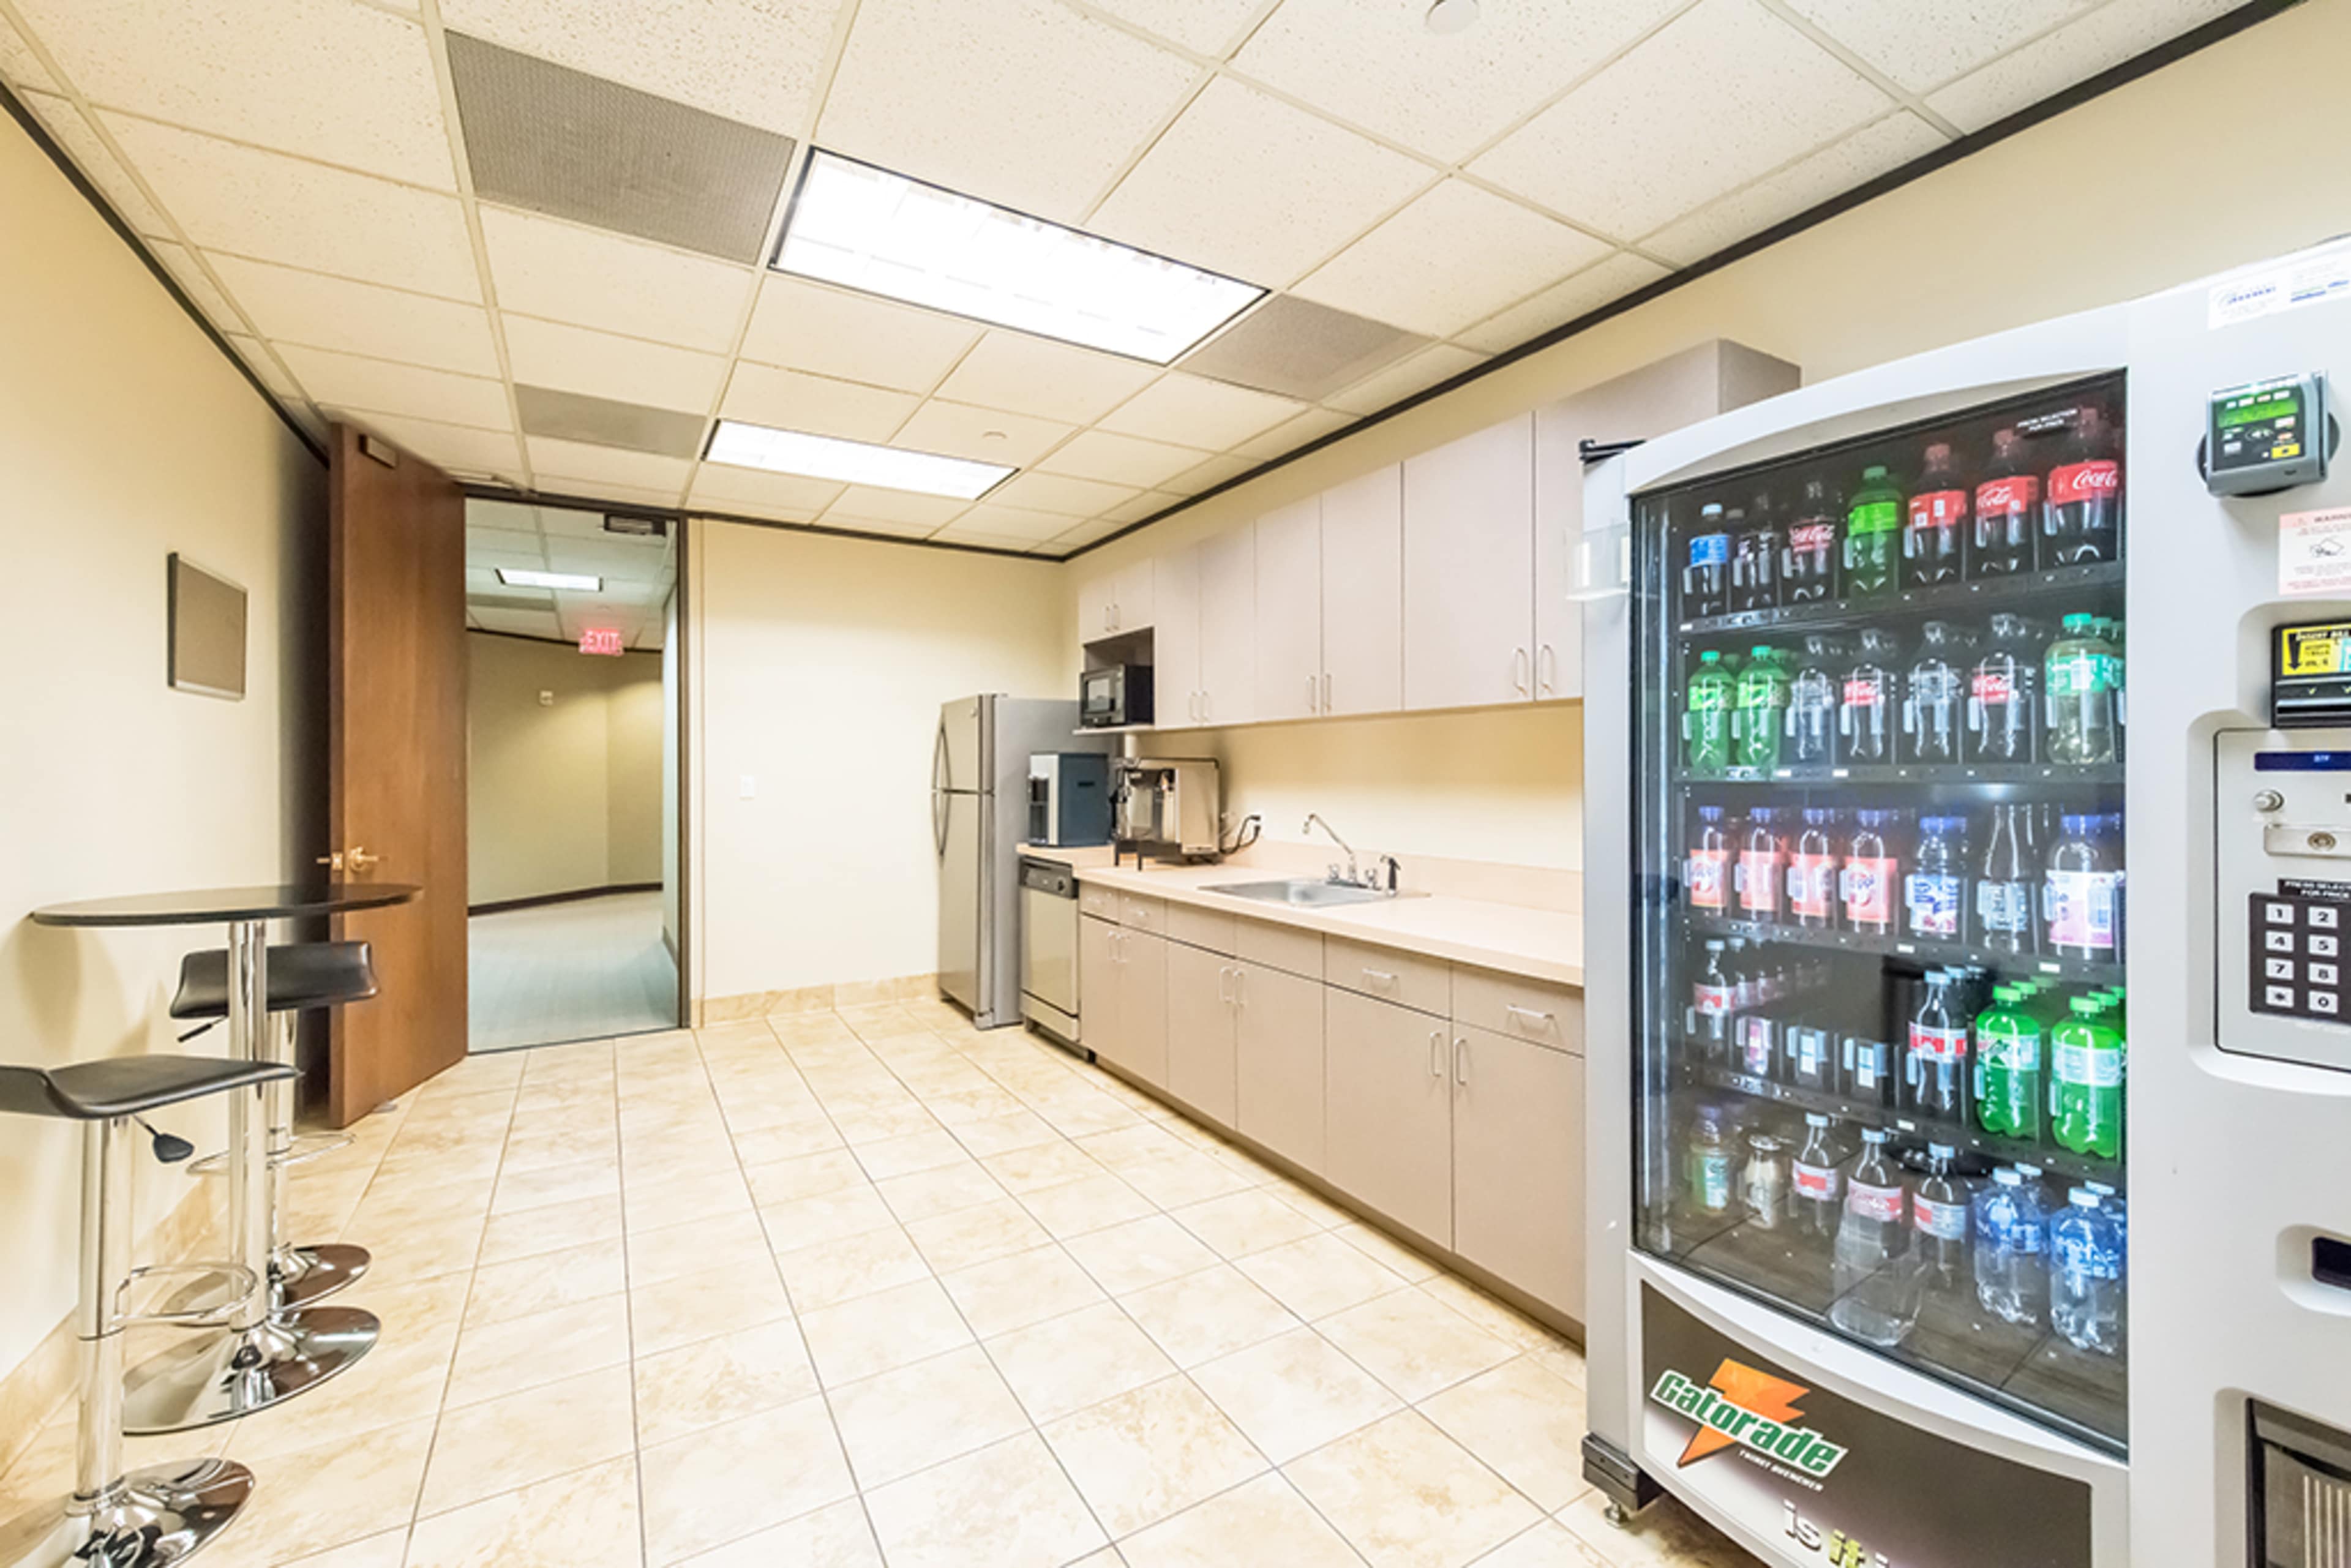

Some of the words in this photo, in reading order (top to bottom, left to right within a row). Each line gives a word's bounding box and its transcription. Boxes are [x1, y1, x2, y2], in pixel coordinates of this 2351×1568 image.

[585, 630, 618, 652] EXIT
[2276, 908, 2283, 918] 1
[2317, 910, 2329, 923] 2
[2274, 936, 2285, 947] 4
[2318, 939, 2329, 951] 5
[2274, 963, 2285, 975] 7
[2318, 996, 2330, 1008] 0
[1652, 1371, 1843, 1474] Gatorade
[1783, 1499, 1822, 1551] is
